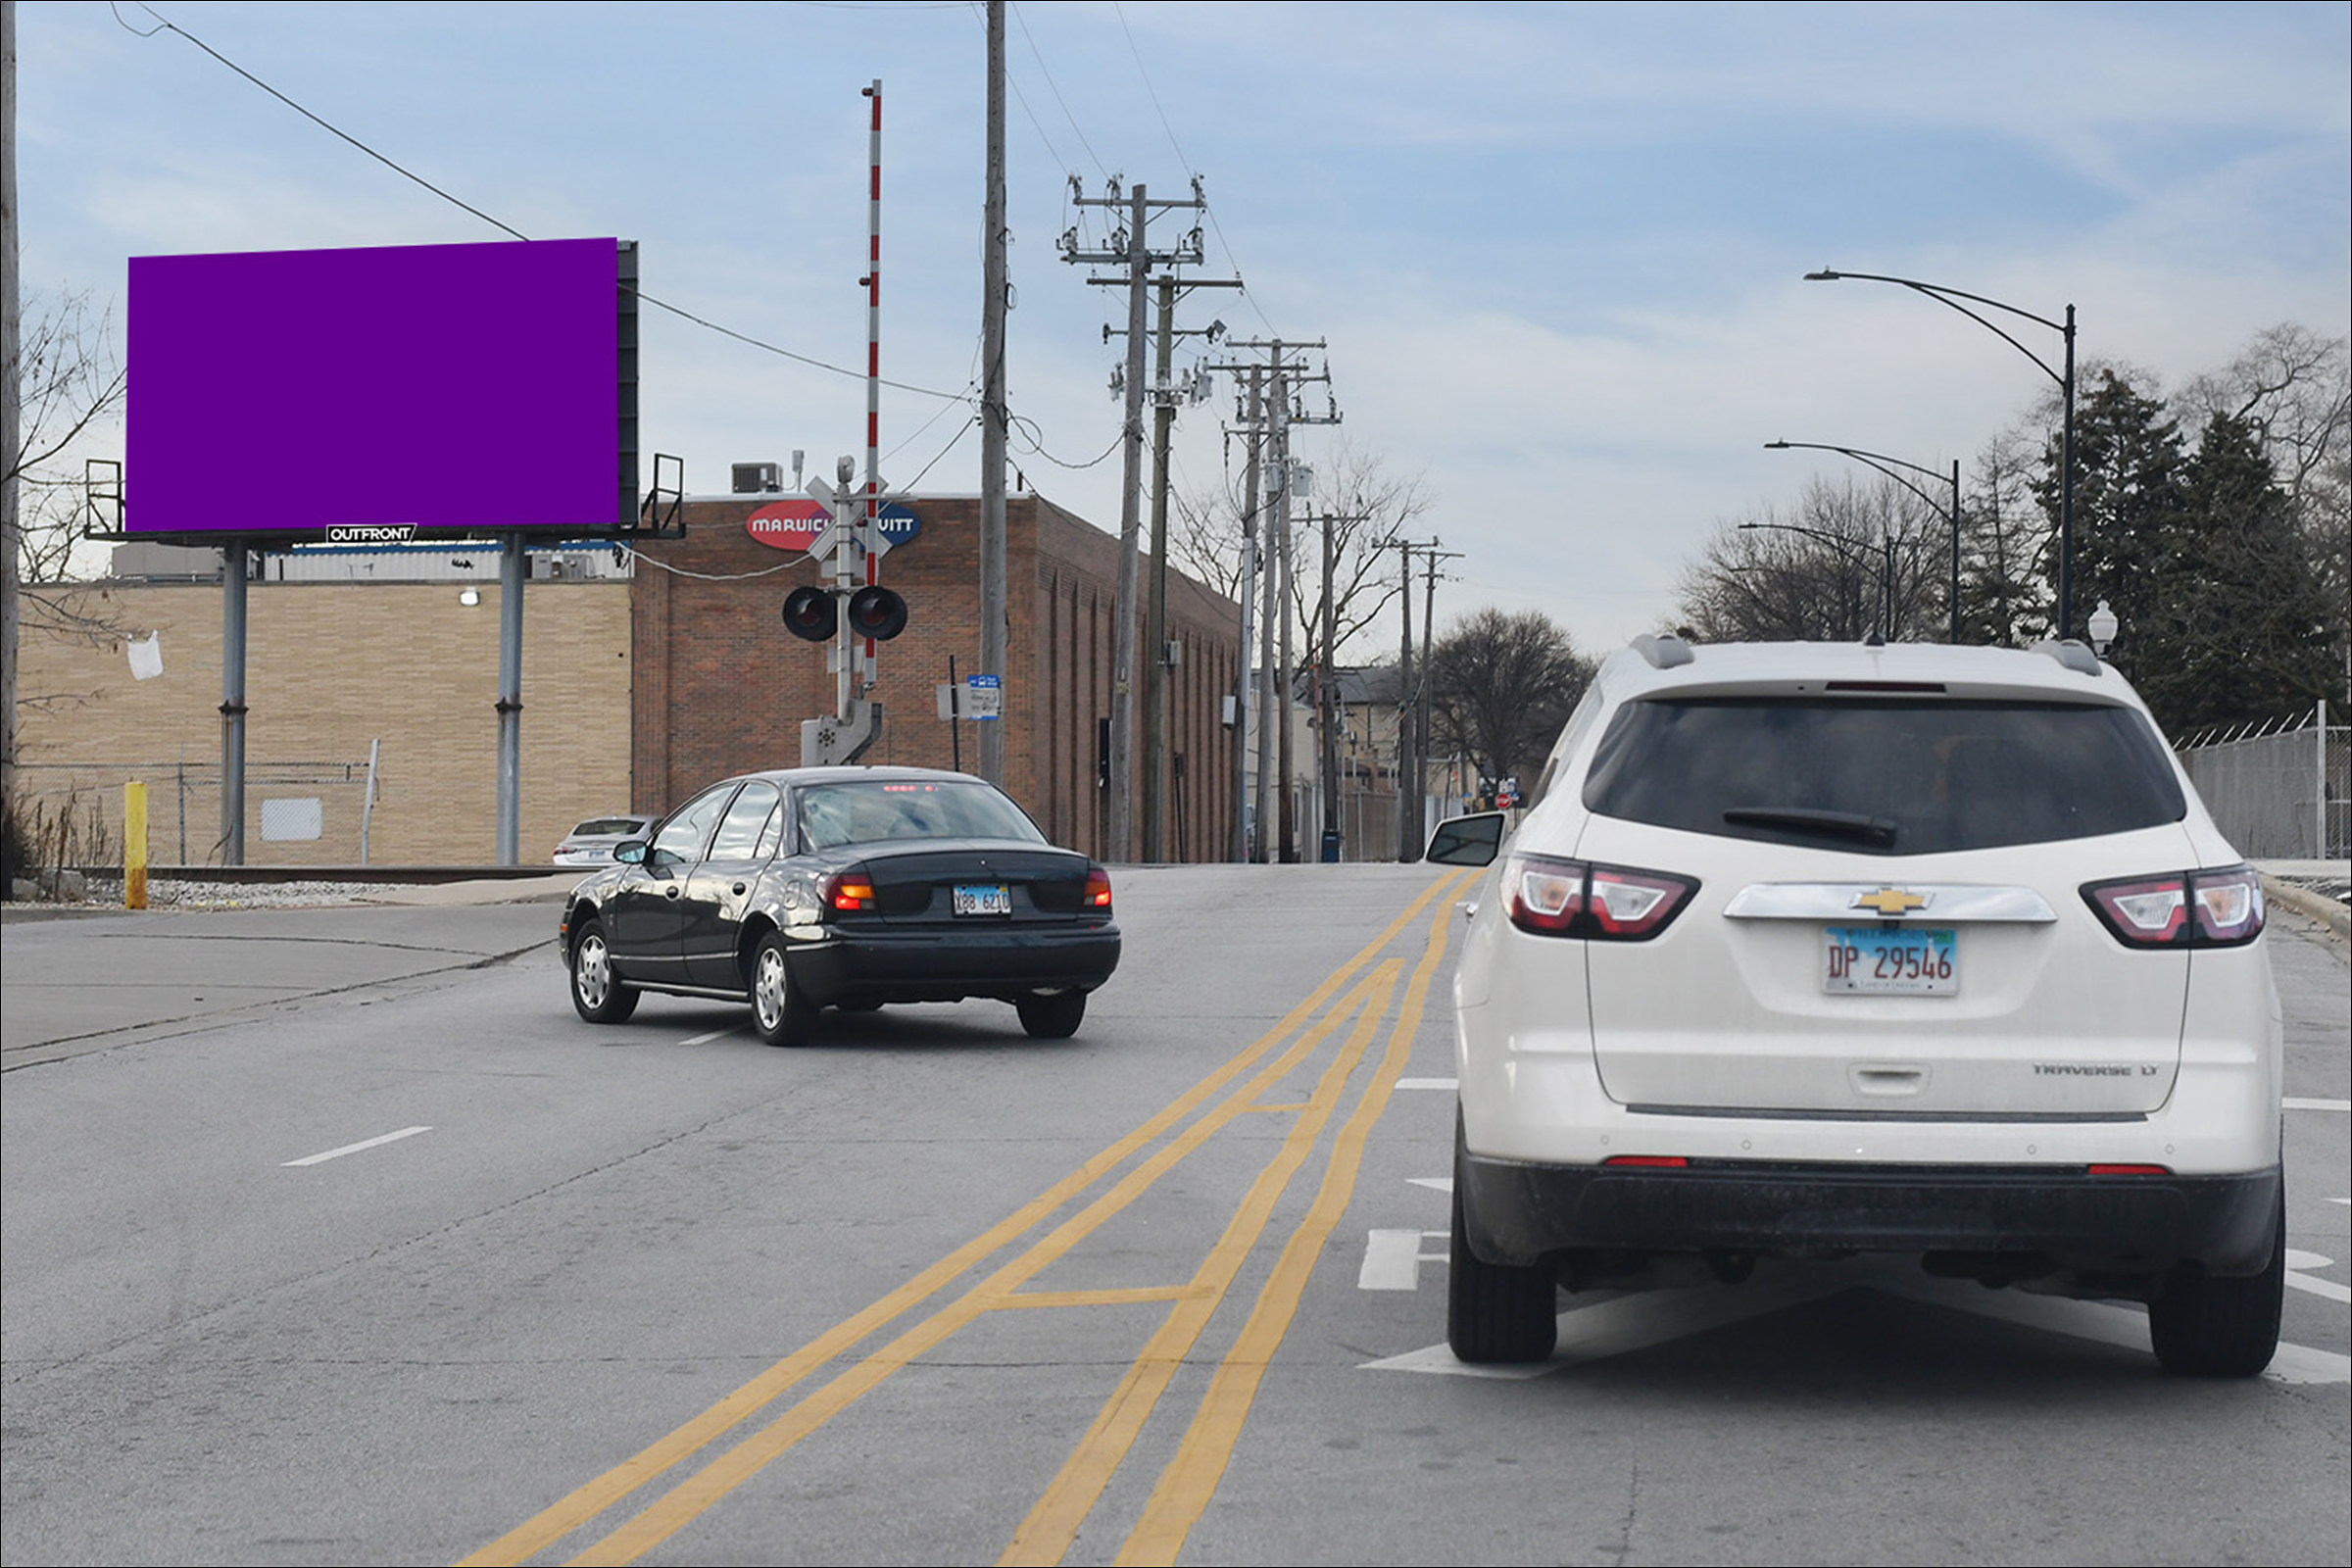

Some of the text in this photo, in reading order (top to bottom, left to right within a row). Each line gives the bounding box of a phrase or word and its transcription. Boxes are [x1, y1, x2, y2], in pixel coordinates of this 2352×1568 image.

[752, 517, 829, 532] MARUIC
[330, 526, 412, 541] OUTFRONT
[983, 893, 1010, 910] 6210
[1829, 945, 1952, 980] DP 29546
[2033, 1062, 2159, 1077] TRAVERSE LT
